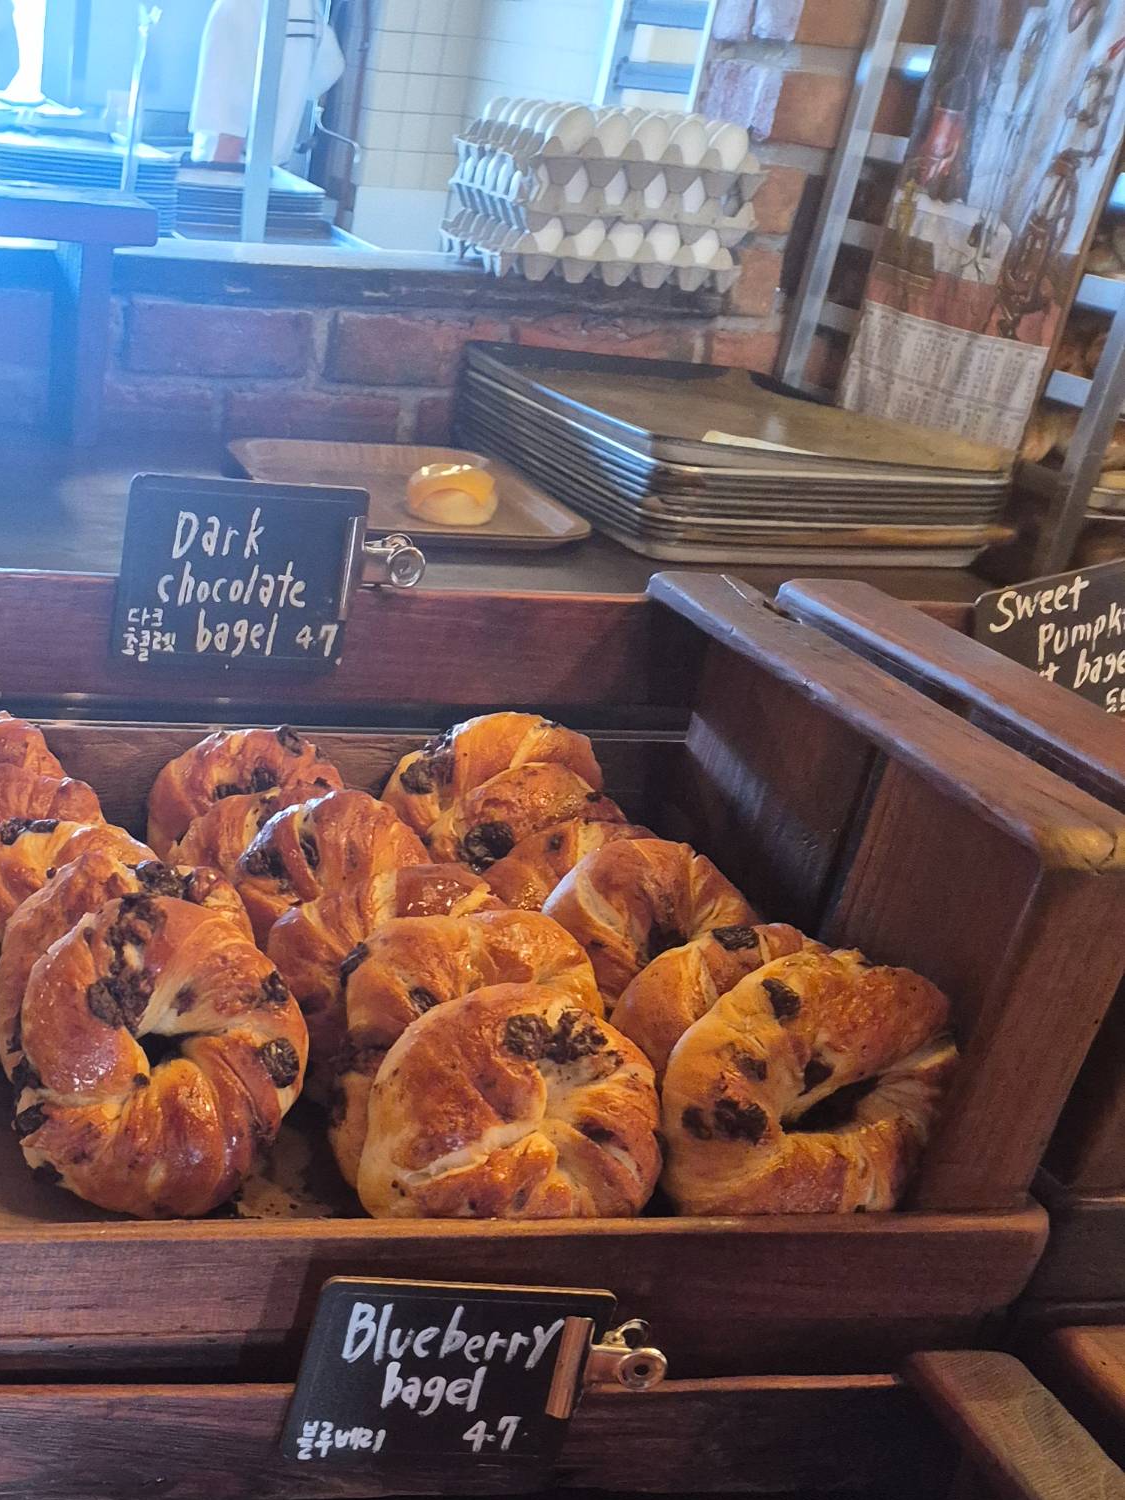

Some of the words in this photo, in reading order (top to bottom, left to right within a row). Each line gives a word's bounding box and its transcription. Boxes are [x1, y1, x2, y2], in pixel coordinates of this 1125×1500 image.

[172, 507, 265, 559] Dark
[156, 561, 307, 608] chocolate
[989, 575, 1091, 633] Sweet
[127, 607, 164, 627] 다크
[195, 608, 279, 659] bagel
[1037, 602, 1125, 665] Pumpk
[1073, 648, 1125, 689] bage
[341, 1301, 566, 1370] Blueberry
[379, 1360, 488, 1417] bagel
[296, 1420, 387, 1461] 블루베리
